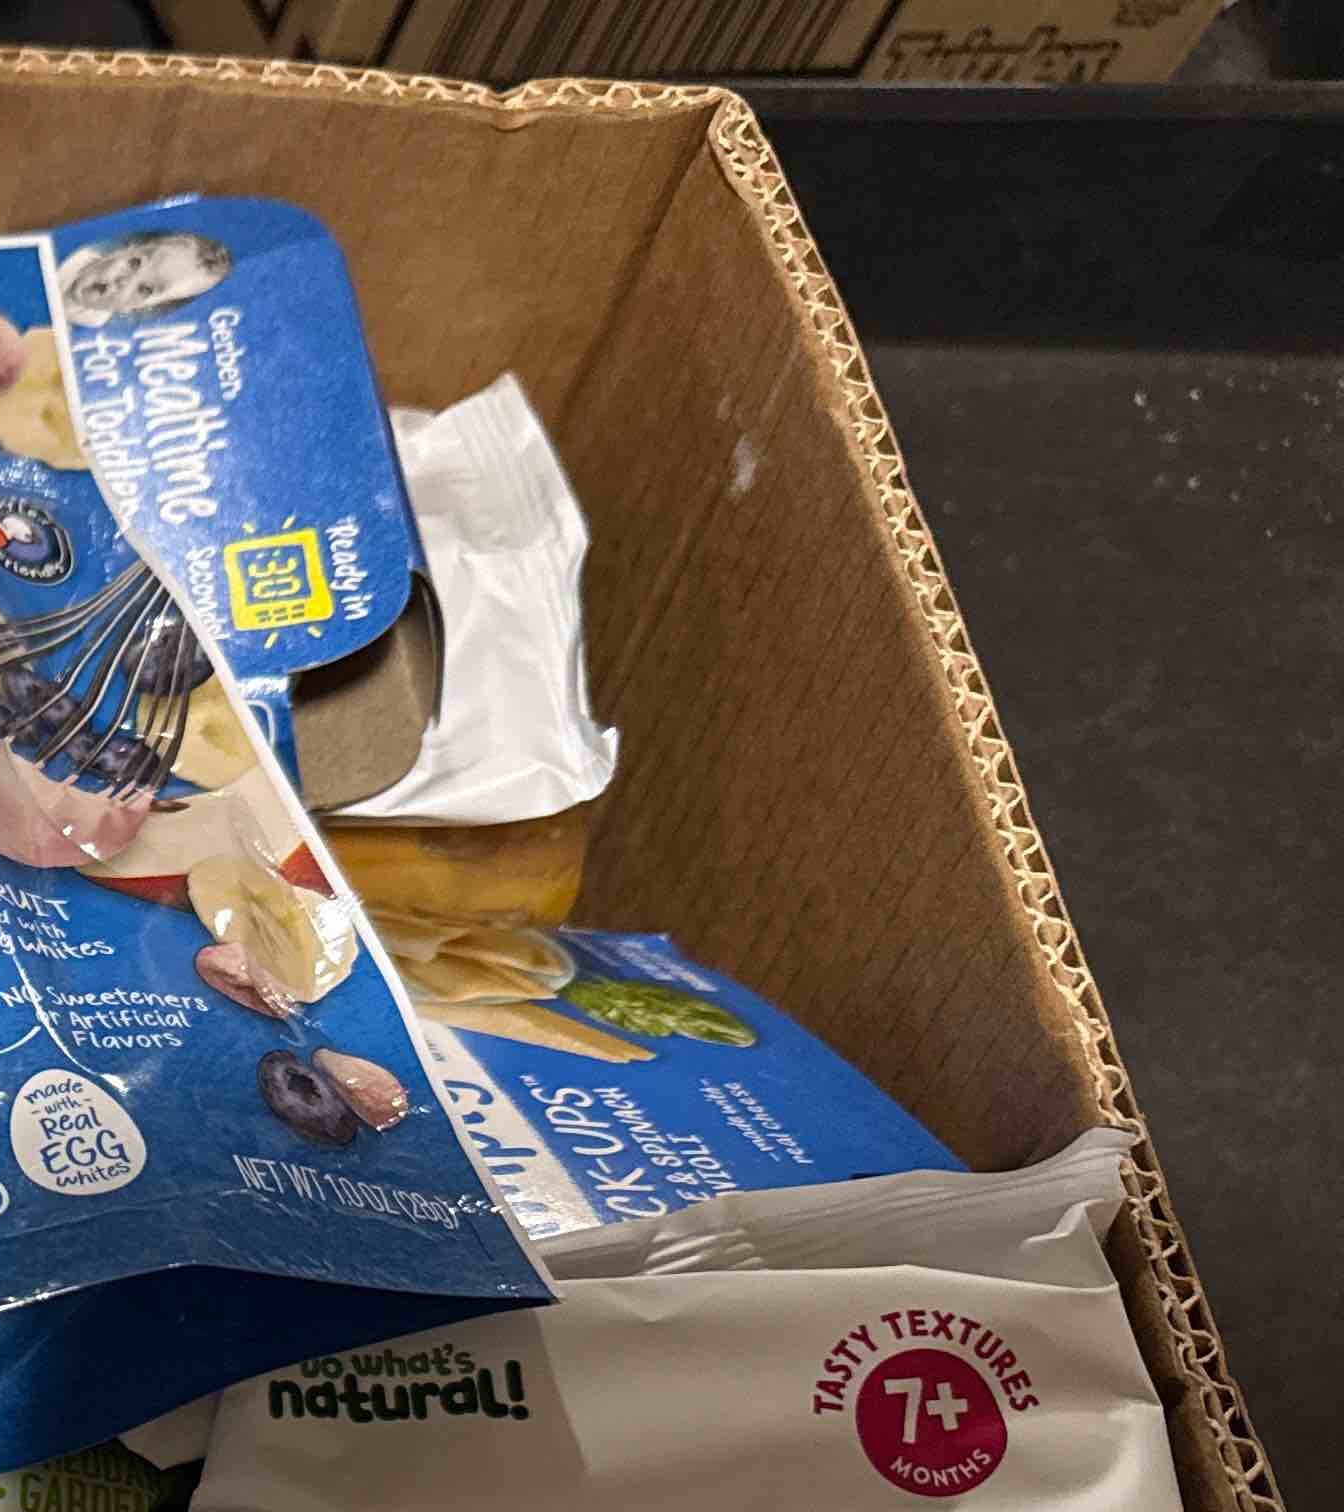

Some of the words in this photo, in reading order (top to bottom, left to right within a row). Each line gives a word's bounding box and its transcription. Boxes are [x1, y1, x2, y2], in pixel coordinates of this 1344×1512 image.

[131, 324, 218, 524] Mealtime
[326, 518, 362, 602] Ready
[18, 937, 114, 958] whites
[46, 987, 208, 1011] Sweeteners
[70, 1010, 192, 1029] Artificial
[72, 1030, 183, 1048] Flavors
[39, 1107, 102, 1138] Real
[595, 1086, 682, 1169] SPINACH
[40, 1131, 129, 1174] EGG
[56, 1162, 130, 1188] whites
[233, 1153, 279, 1190] NET
[285, 1165, 321, 1200] WT
[324, 1169, 353, 1207] 1.0
[358, 1181, 396, 1216] OZ
[399, 1191, 456, 1230] (28g)
[350, 1342, 476, 1377] what's
[814, 1325, 878, 1415] TASTY
[880, 1310, 1040, 1411] TEXTURES
[268, 1361, 529, 1424] natural!
[883, 1378, 968, 1444] 7+
[890, 1448, 991, 1487] MONTHS
